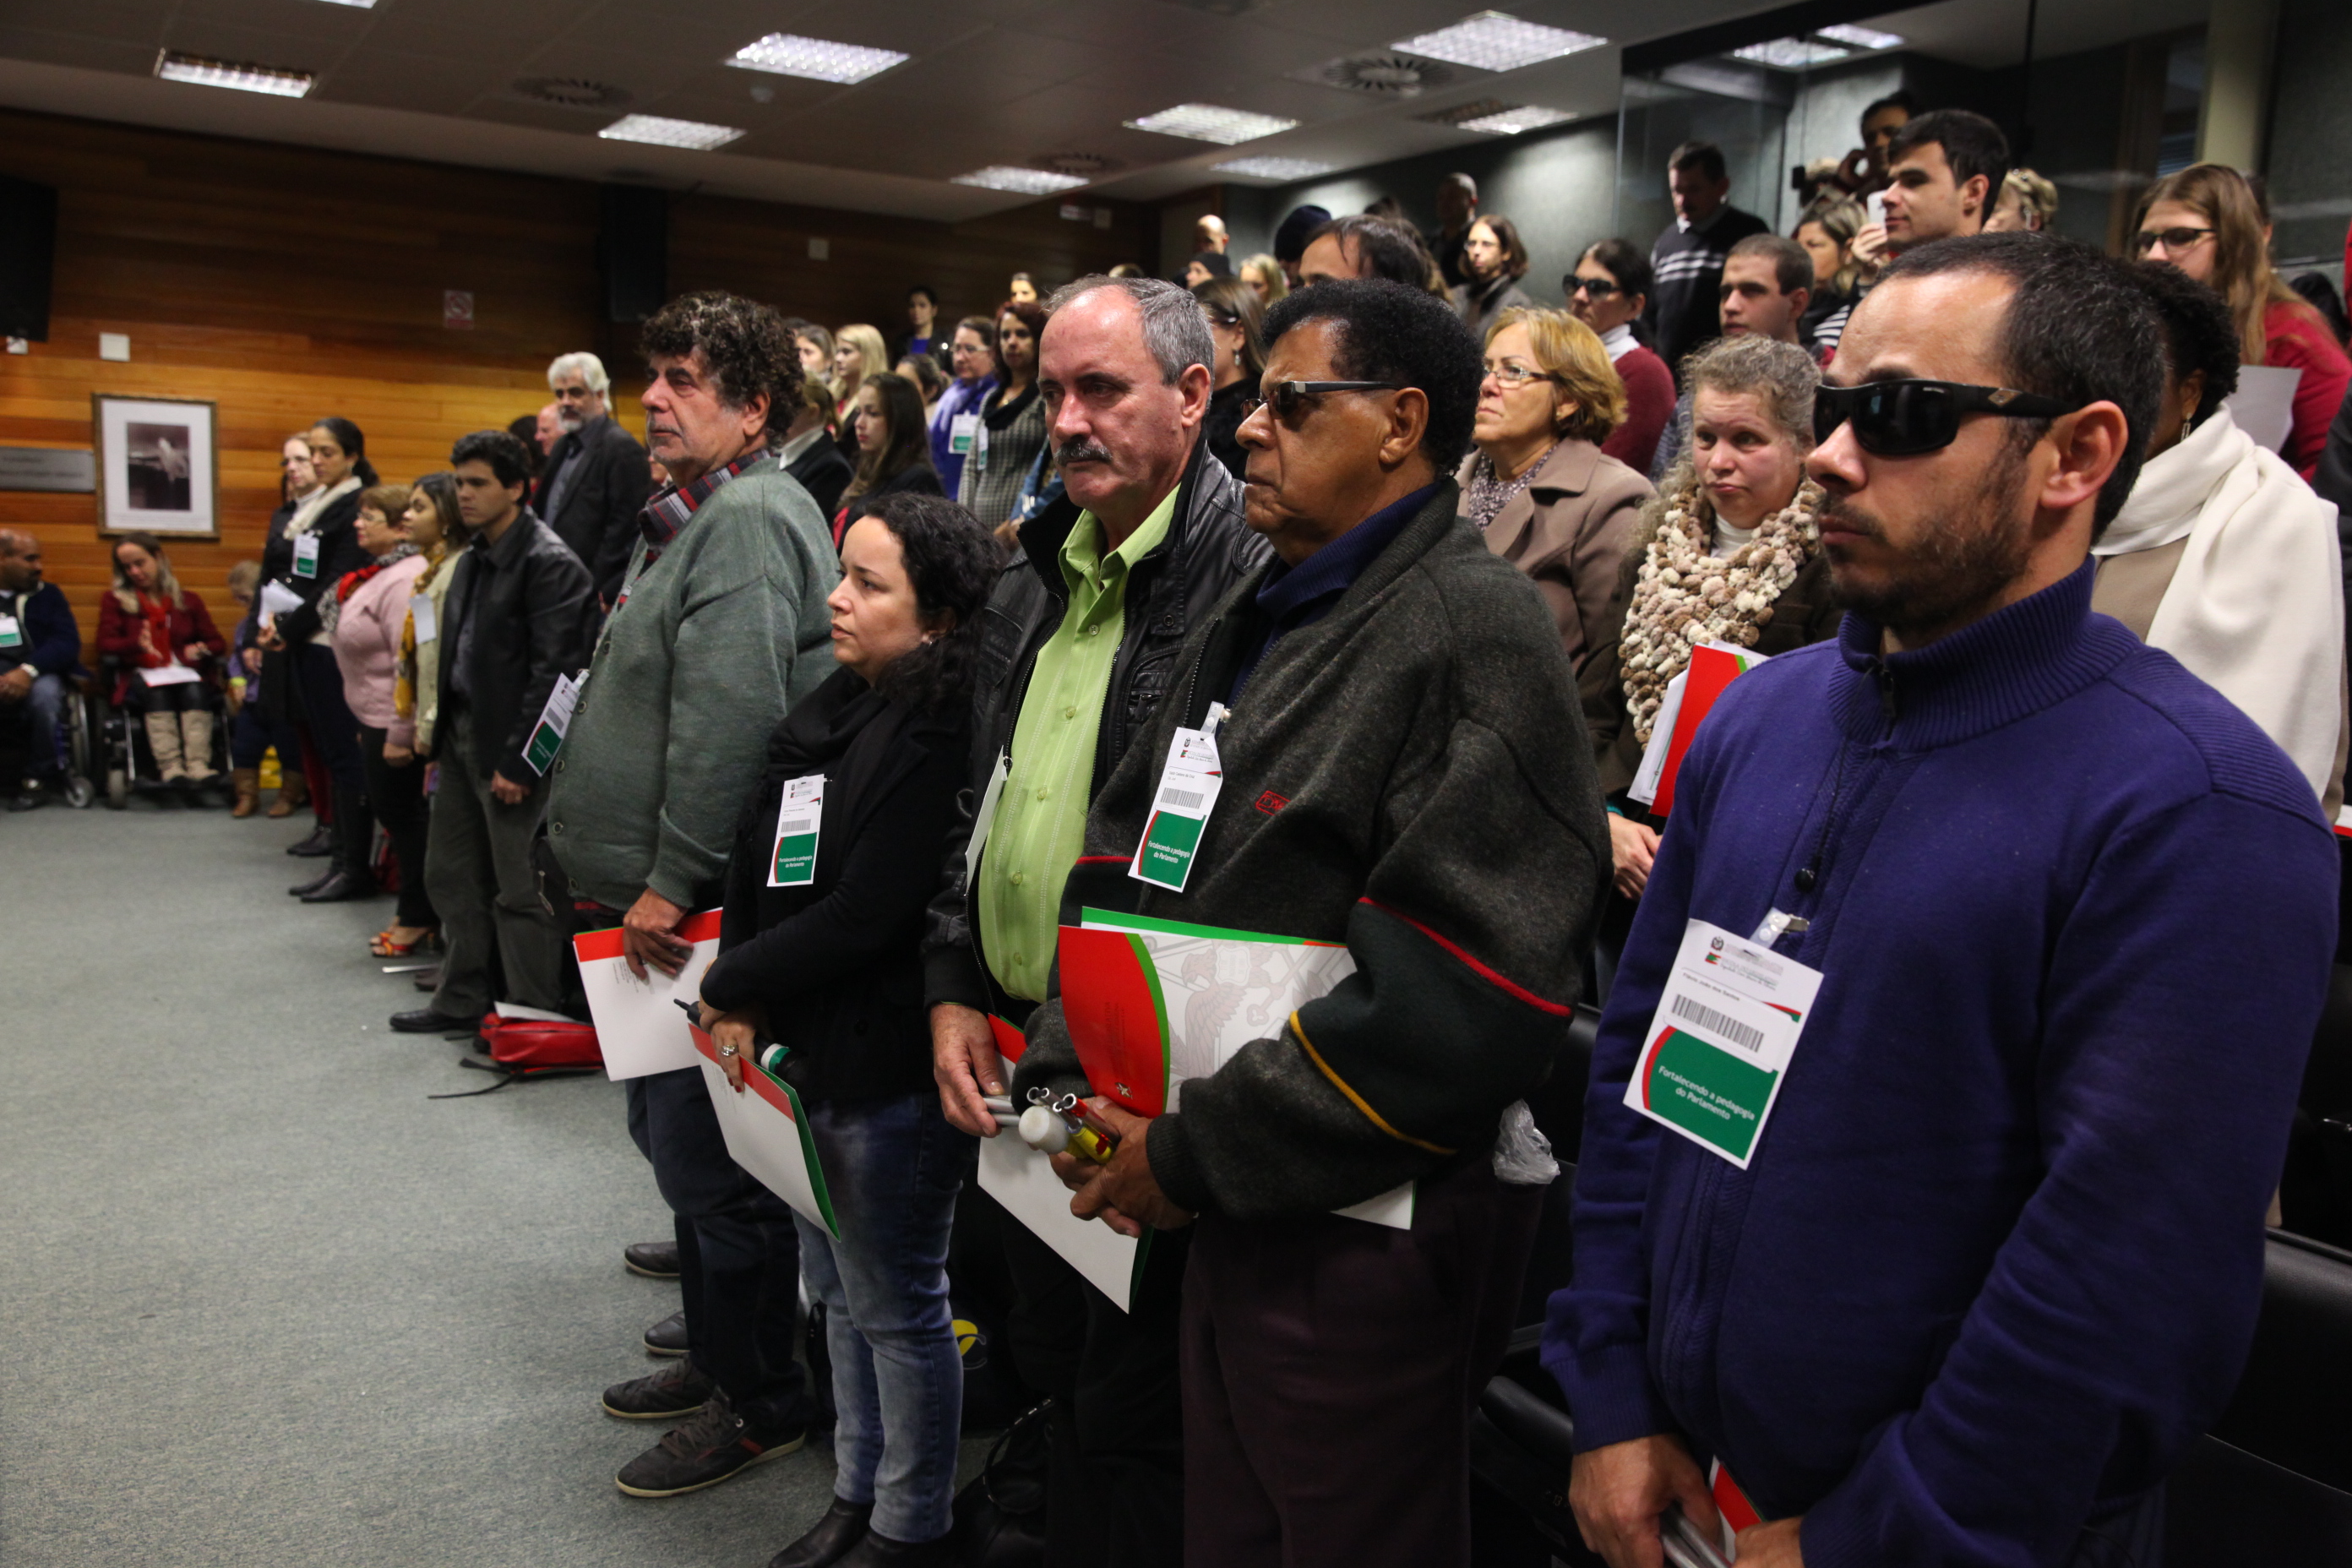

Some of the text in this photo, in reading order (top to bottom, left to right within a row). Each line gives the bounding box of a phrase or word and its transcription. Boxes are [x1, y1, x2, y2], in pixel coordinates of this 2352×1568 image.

[1148, 841, 1170, 852] Fortalecendo
[1173, 848, 1190, 858] pedagogia
[1159, 852, 1179, 863] Parlamento
[1658, 1065, 1755, 1120] Fortalecendo a pedagogia
[1675, 1087, 1730, 1120] do Parlamento
